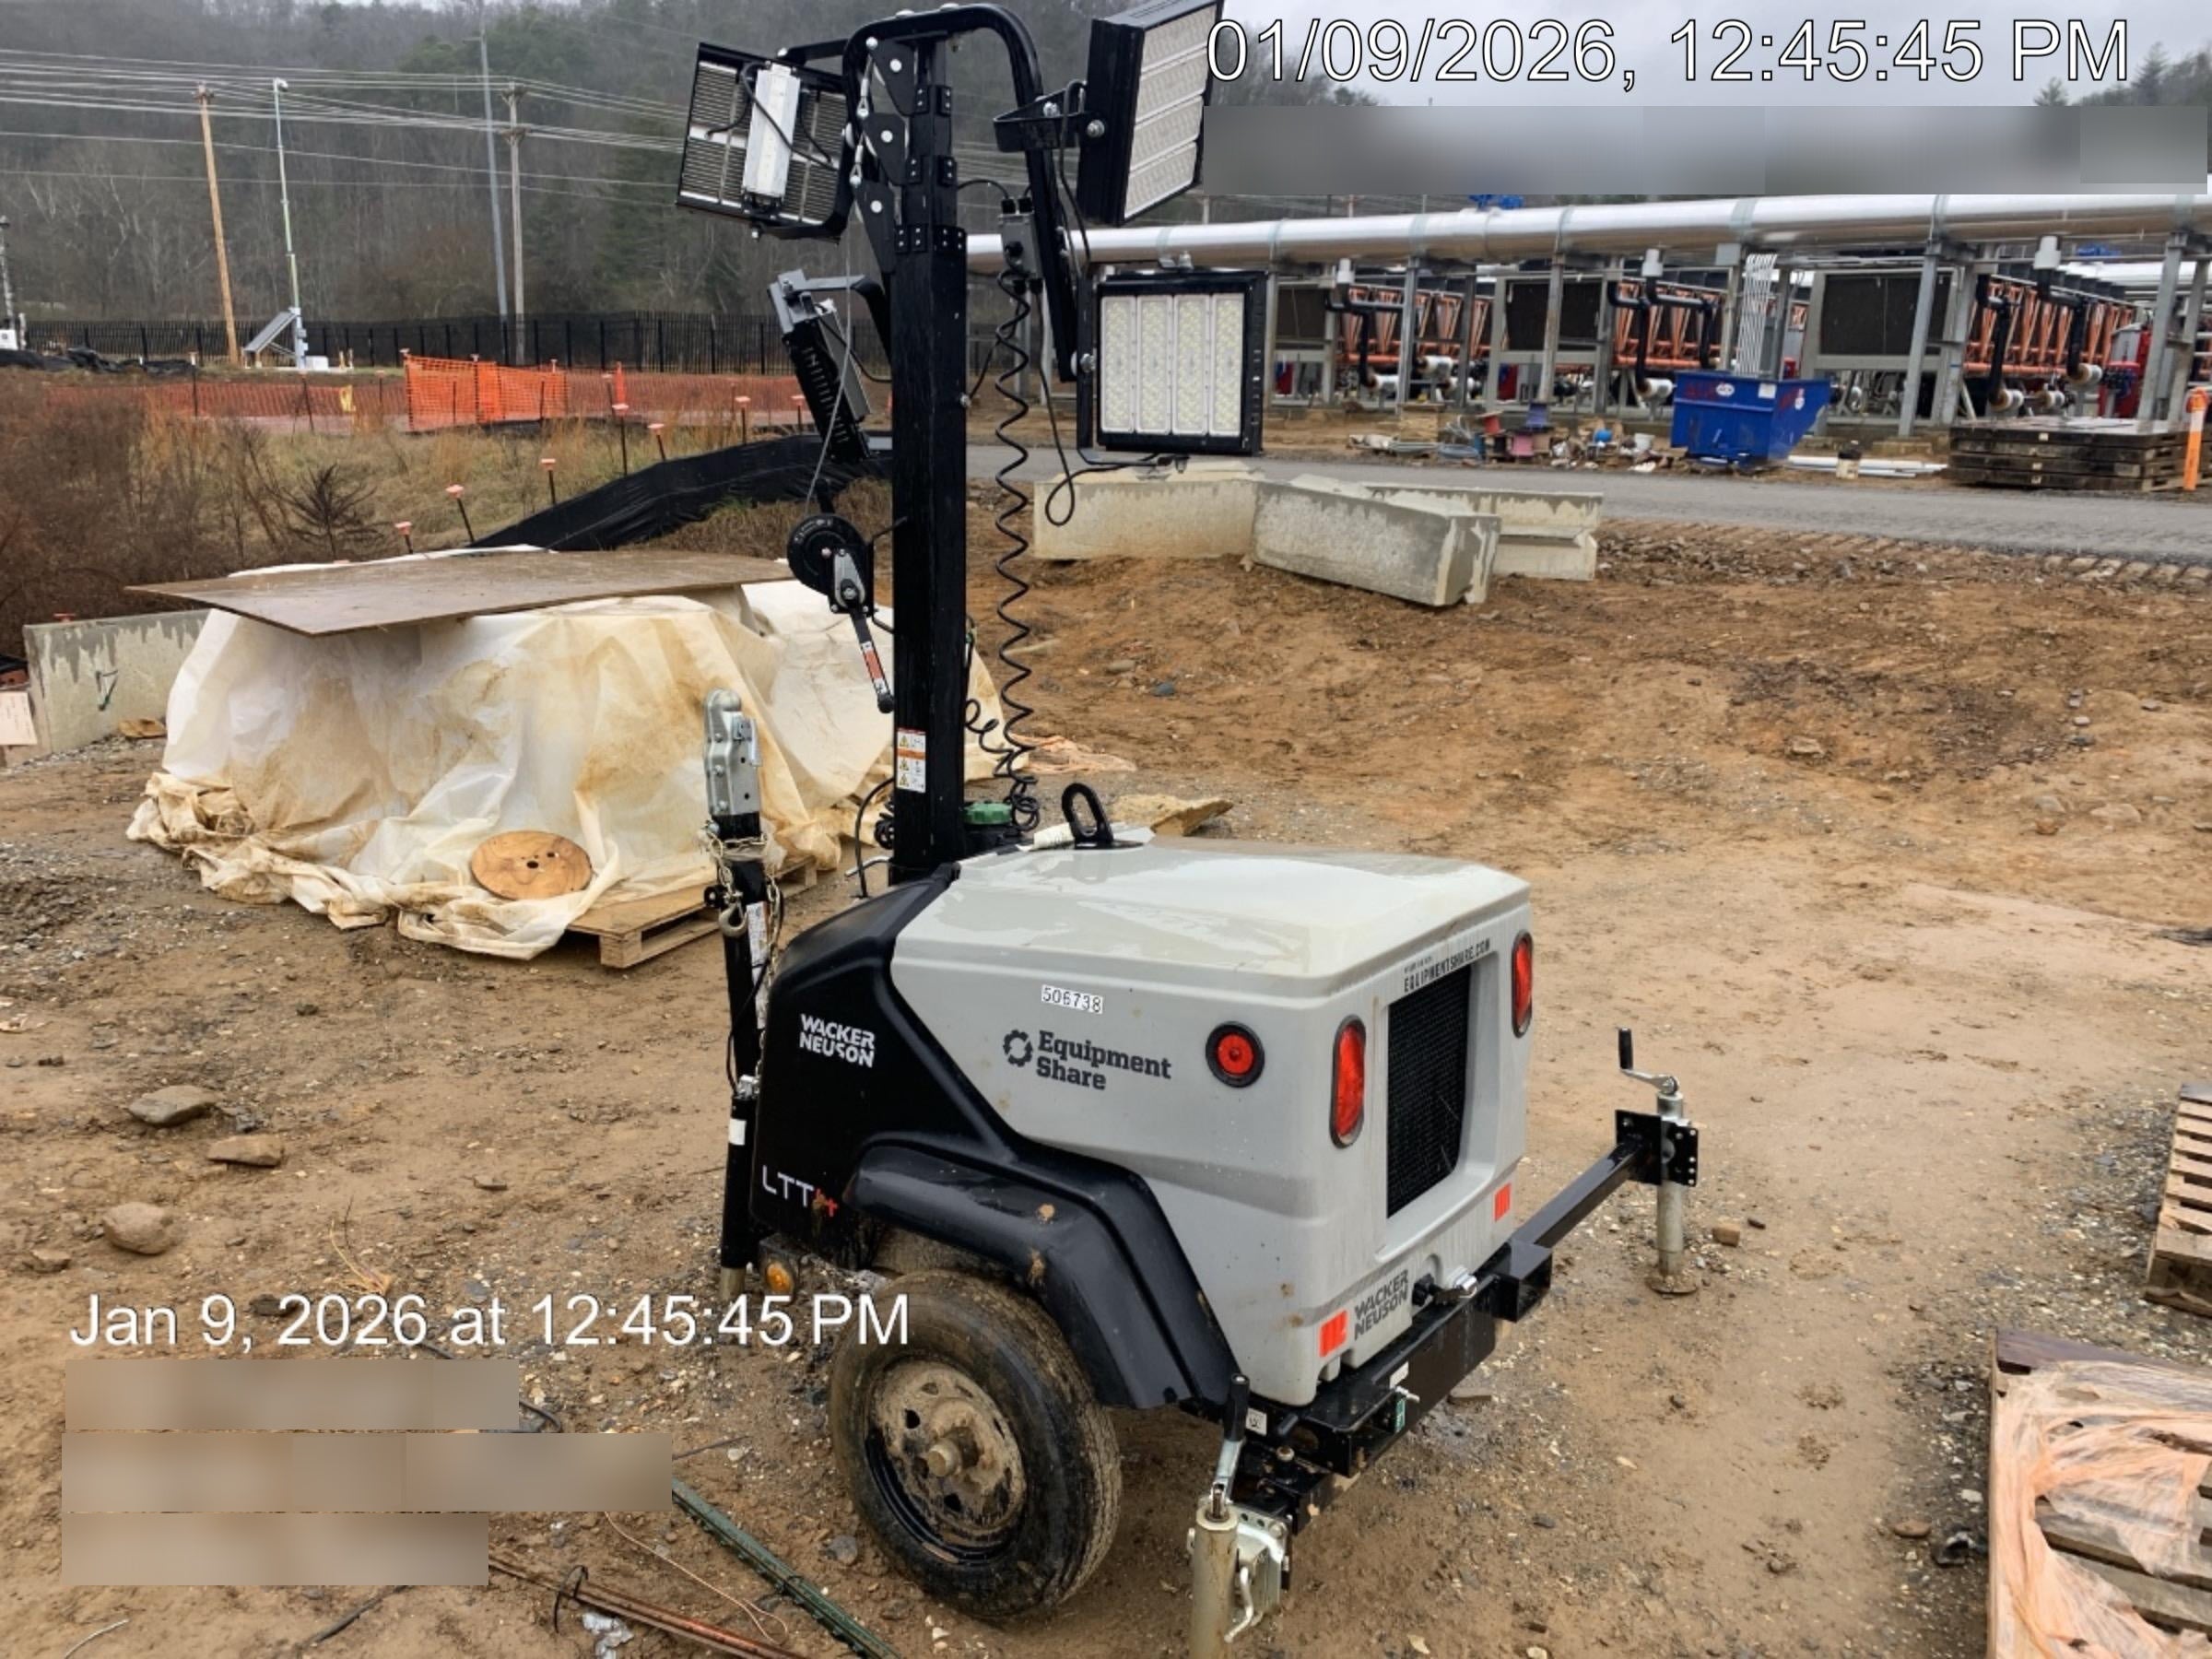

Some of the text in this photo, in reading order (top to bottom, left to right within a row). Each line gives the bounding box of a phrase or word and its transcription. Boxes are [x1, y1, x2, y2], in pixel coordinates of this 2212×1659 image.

[1042, 986, 1101, 1012] 506738
[799, 1031, 874, 1067] NEUSON
[800, 1014, 875, 1048] WACKER
[1037, 1056, 1106, 1089] Share
[1038, 1030, 1171, 1079] Equipment
[1354, 1268, 1408, 1321] WACKER
[1354, 1283, 1408, 1341] NEUSON
